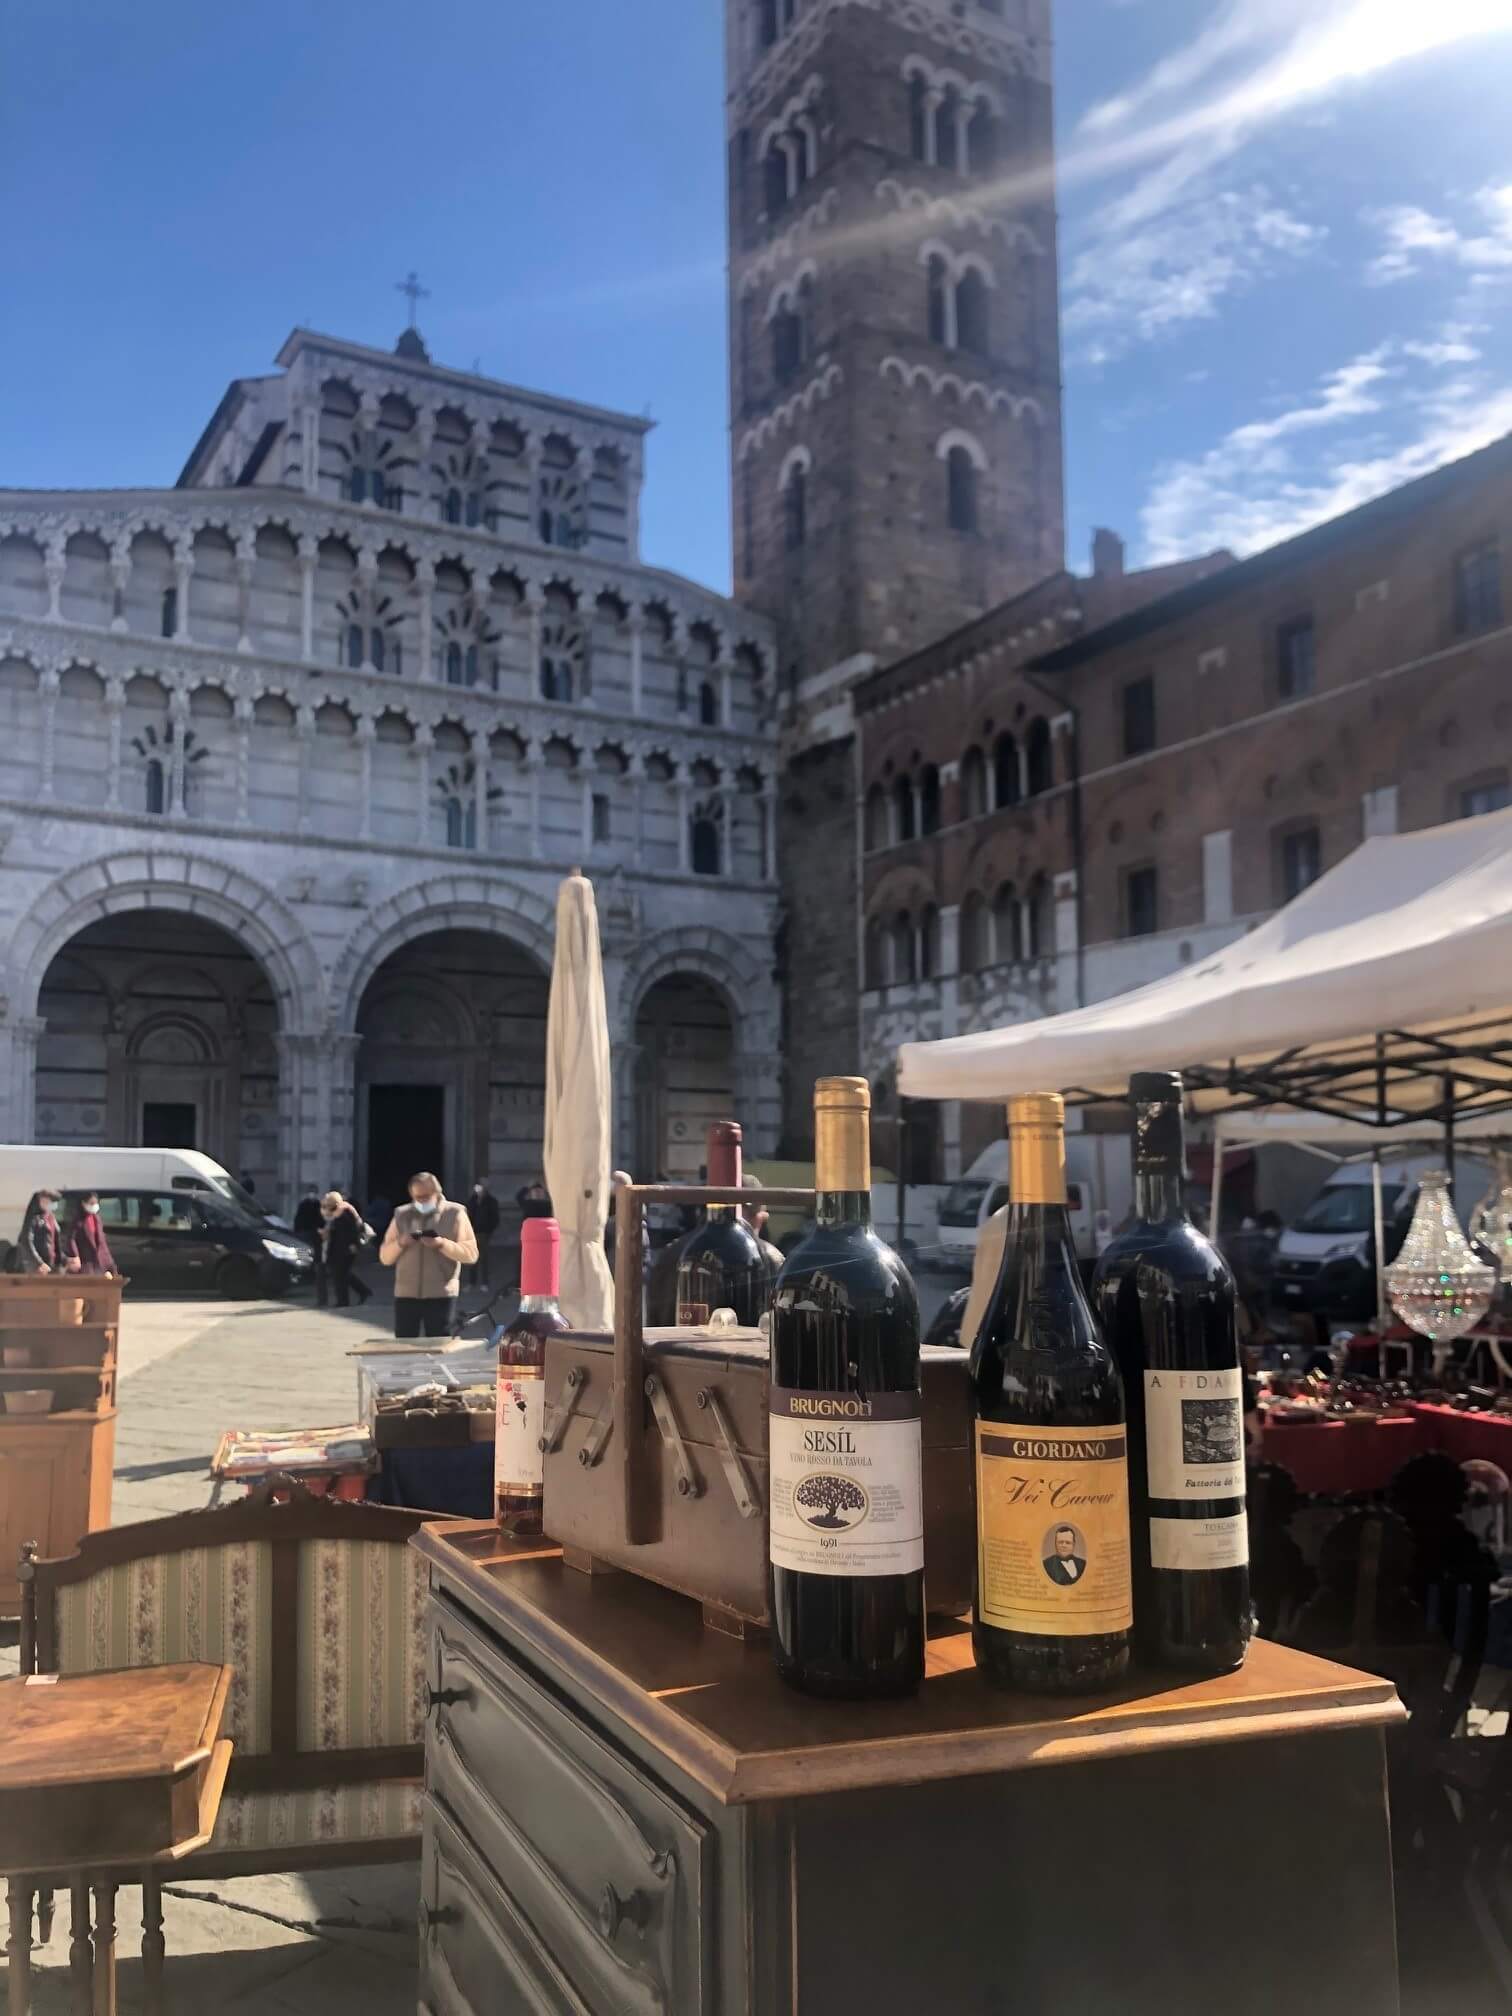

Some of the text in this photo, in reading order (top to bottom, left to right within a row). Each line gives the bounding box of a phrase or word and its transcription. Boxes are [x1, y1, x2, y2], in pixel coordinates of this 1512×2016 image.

[790, 1397, 872, 1417] BRUGNOLI
[804, 1426, 856, 1453] SESÍL
[1013, 1440, 1106, 1458] GIORDANO
[789, 1453, 873, 1467] VINO ROSSO DA TAVOLA
[1184, 1478, 1222, 1488] Fattoria
[1048, 1479, 1114, 1508] Cavour
[820, 1537, 838, 1549] 1991
